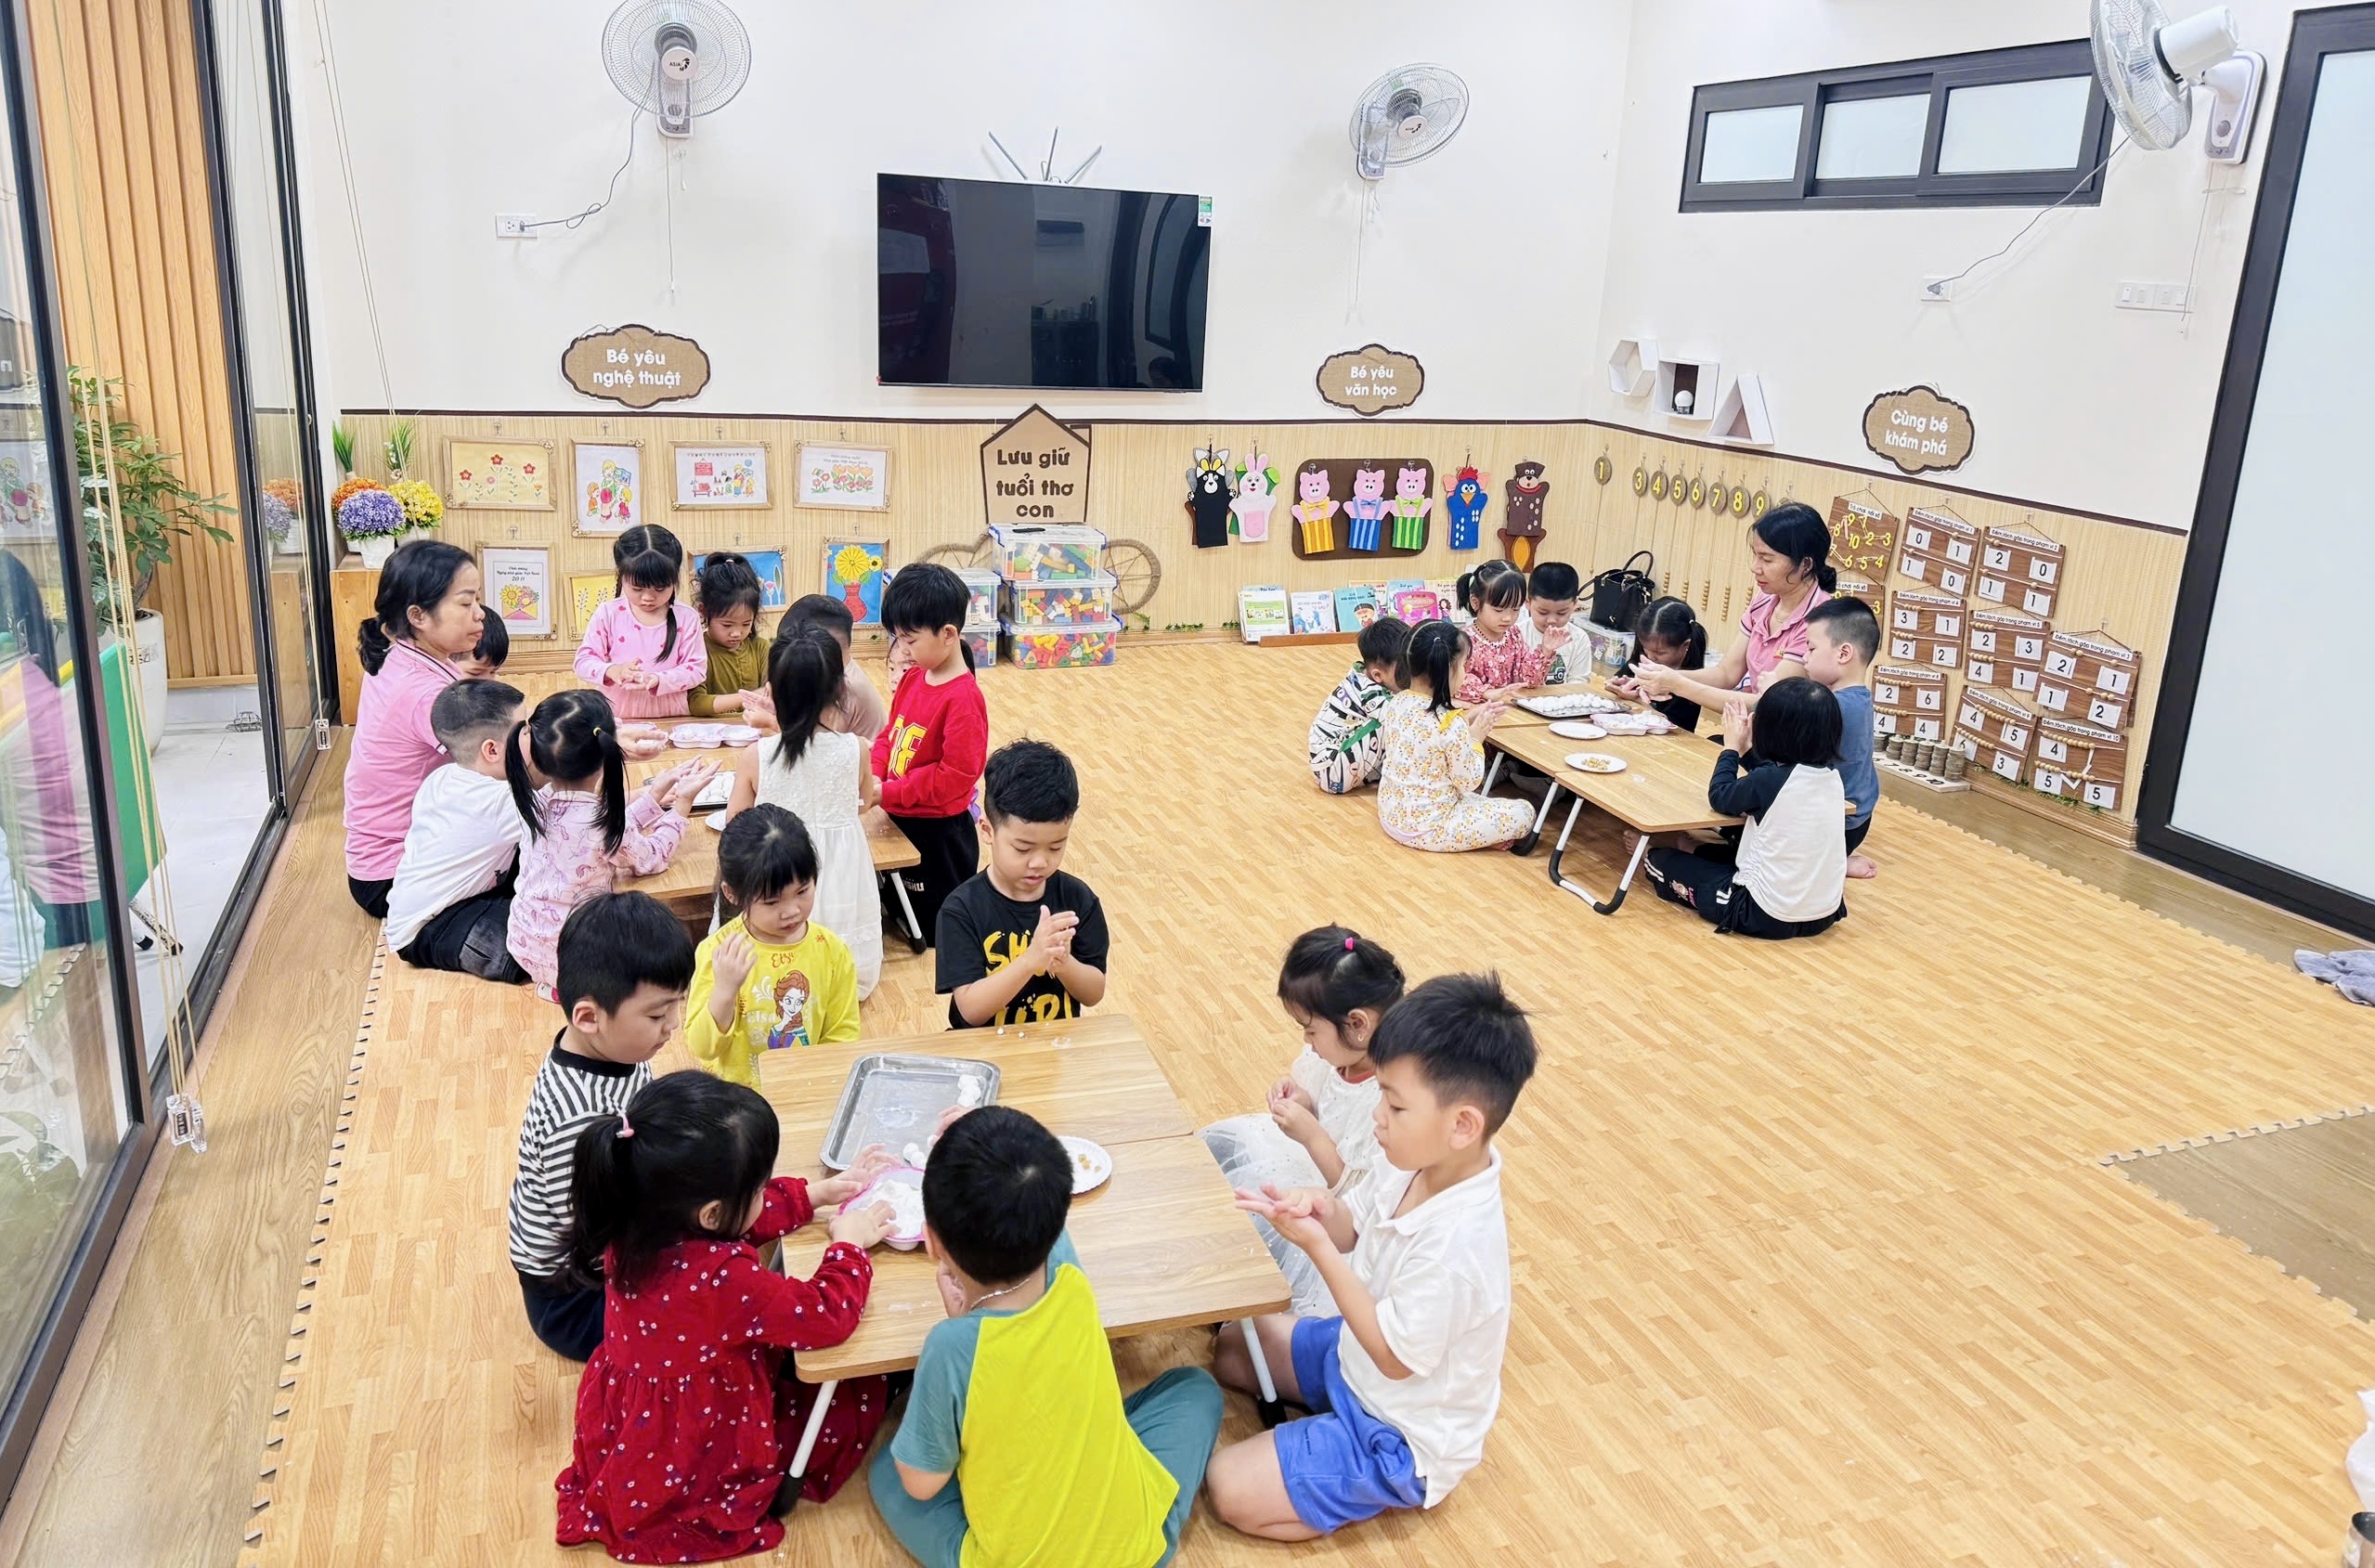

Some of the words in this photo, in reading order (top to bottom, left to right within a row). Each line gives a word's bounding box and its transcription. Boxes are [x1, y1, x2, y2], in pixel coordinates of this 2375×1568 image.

[606, 347, 629, 364] Bé
[633, 349, 666, 367] yêu
[593, 369, 635, 388] nghệ
[639, 370, 681, 389] thuật
[1351, 365, 1368, 379] Bé
[1370, 365, 1394, 381] yêu
[1344, 383, 1369, 395] văn
[1373, 383, 1397, 399] học
[1890, 409, 1927, 433] Cùng
[1929, 416, 1948, 434] bé
[1885, 430, 1919, 449] khám
[1921, 438, 1948, 456] phá
[997, 448, 1032, 465] Lưu
[1039, 447, 1071, 469] giữ
[996, 473, 1034, 497] tuổi
[1042, 480, 1074, 497] thơ
[1598, 462, 1603, 479] 1
[1635, 473, 1642, 490] 3
[1653, 476, 1662, 494] 4
[1673, 480, 1681, 499] 5
[1692, 483, 1700, 502] 6
[1712, 488, 1720, 508] 7
[1733, 492, 1743, 512] 8
[1756, 497, 1764, 515] 9
[1016, 504, 1055, 518] con
[1848, 512, 1856, 526] 9
[1833, 523, 1841, 537] 8
[1848, 533, 1861, 550] 10
[1865, 531, 1875, 546] 2
[1882, 532, 1891, 547] 3
[1915, 533, 1923, 544] 0
[1956, 545, 1960, 557] 1
[1995, 551, 2004, 564] 2
[1844, 554, 1853, 568] 6
[1858, 556, 1868, 570] 5
[1875, 554, 1885, 568] 4
[1907, 560, 1911, 571] 1
[2039, 564, 2047, 577] 0
[1948, 575, 1955, 587] 0
[1988, 581, 1992, 593] 1
[2031, 594, 2036, 606] 1
[1873, 601, 1880, 615] 3
[1901, 612, 1907, 624] 3
[1946, 619, 1950, 631] 1
[1982, 634, 1990, 646] 2
[1901, 643, 1909, 655] 2
[2025, 641, 2032, 654] 3
[1938, 649, 1945, 661] 2
[1975, 665, 1982, 678] 4
[2057, 659, 2067, 672] 2
[2020, 672, 2024, 685] 1
[2111, 674, 2117, 687] 1
[1886, 687, 1892, 699] 2
[1925, 693, 1931, 705] 6
[2048, 691, 2054, 704] 1
[1970, 711, 1978, 723] 4
[2096, 705, 2104, 719] 2
[1878, 716, 1886, 728] 4
[1919, 722, 1926, 733] 4
[2010, 729, 2018, 742] 5
[2050, 743, 2058, 756] 4
[1997, 757, 2005, 770] 3
[2044, 775, 2052, 788] 5
[2092, 786, 2100, 800] 5
